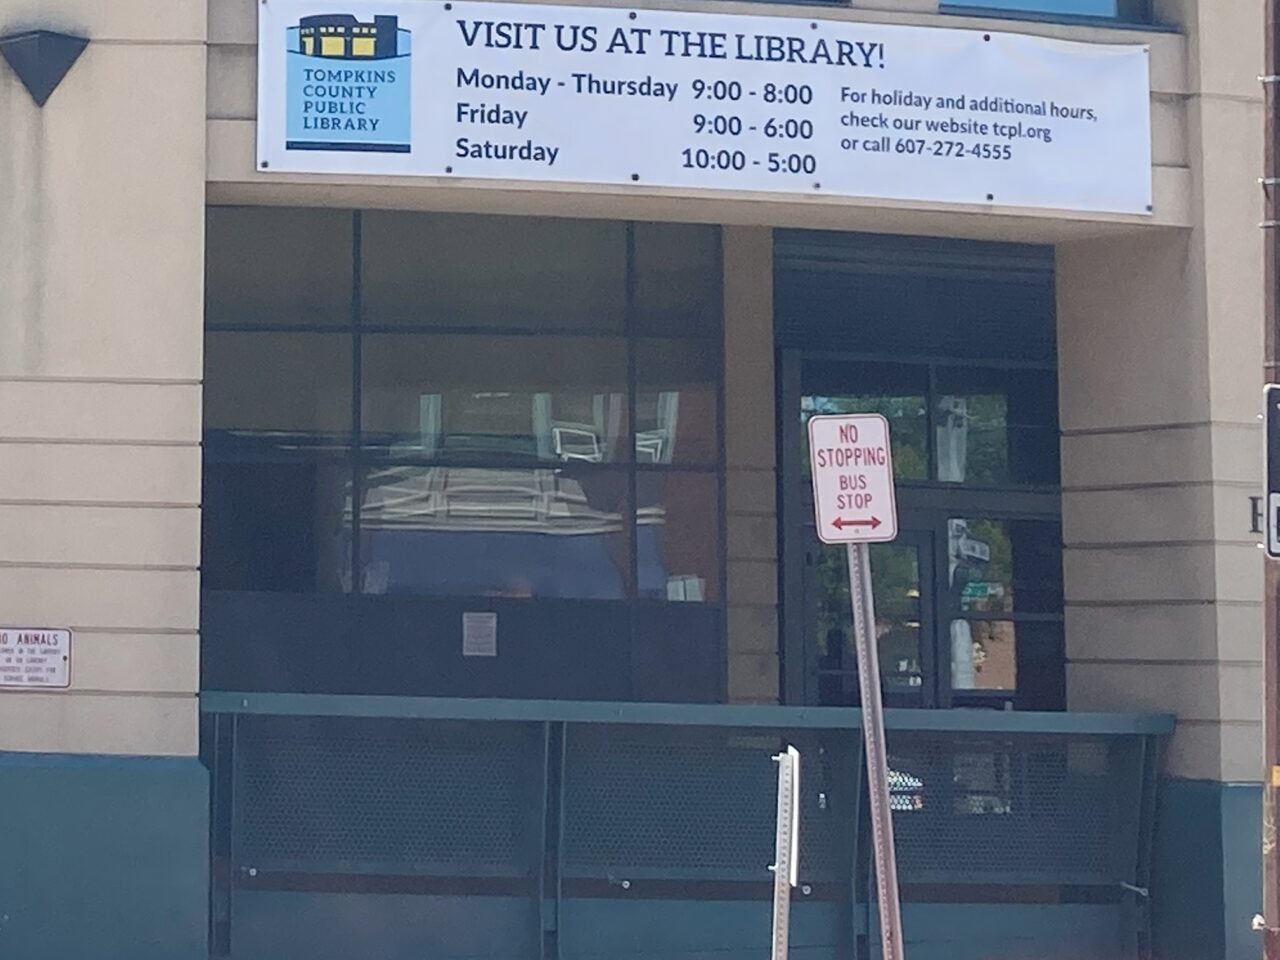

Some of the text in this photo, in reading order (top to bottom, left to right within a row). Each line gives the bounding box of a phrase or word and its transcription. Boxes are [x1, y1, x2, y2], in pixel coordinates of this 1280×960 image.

[456, 20, 885, 69] VISIT US AT THE LIBRARY!
[303, 68, 396, 83] TOMPKINS
[303, 84, 378, 99] COUNTY
[456, 67, 551, 96] Monday
[571, 73, 679, 102] Thursday
[691, 78, 742, 101] 9:00
[763, 82, 813, 105] 8:00
[303, 100, 366, 114] PUBLIC
[840, 87, 1098, 123] For holiday and additional hours,
[303, 116, 380, 131] LIBRARY
[456, 102, 528, 129] Friday
[693, 113, 742, 136] 9:00
[763, 117, 814, 140] 6:00
[840, 111, 1053, 143] check our website tcpl.org
[455, 138, 560, 166] Saturday
[681, 148, 746, 171] 10:00
[767, 152, 817, 175] 5:00
[840, 136, 1013, 160] or call 607-272-4555
[839, 424, 858, 443] NO
[817, 447, 886, 468] STOPPING
[839, 474, 867, 491] BUS
[836, 493, 873, 510] STOP
[16, 633, 59, 646] ANIMALS
